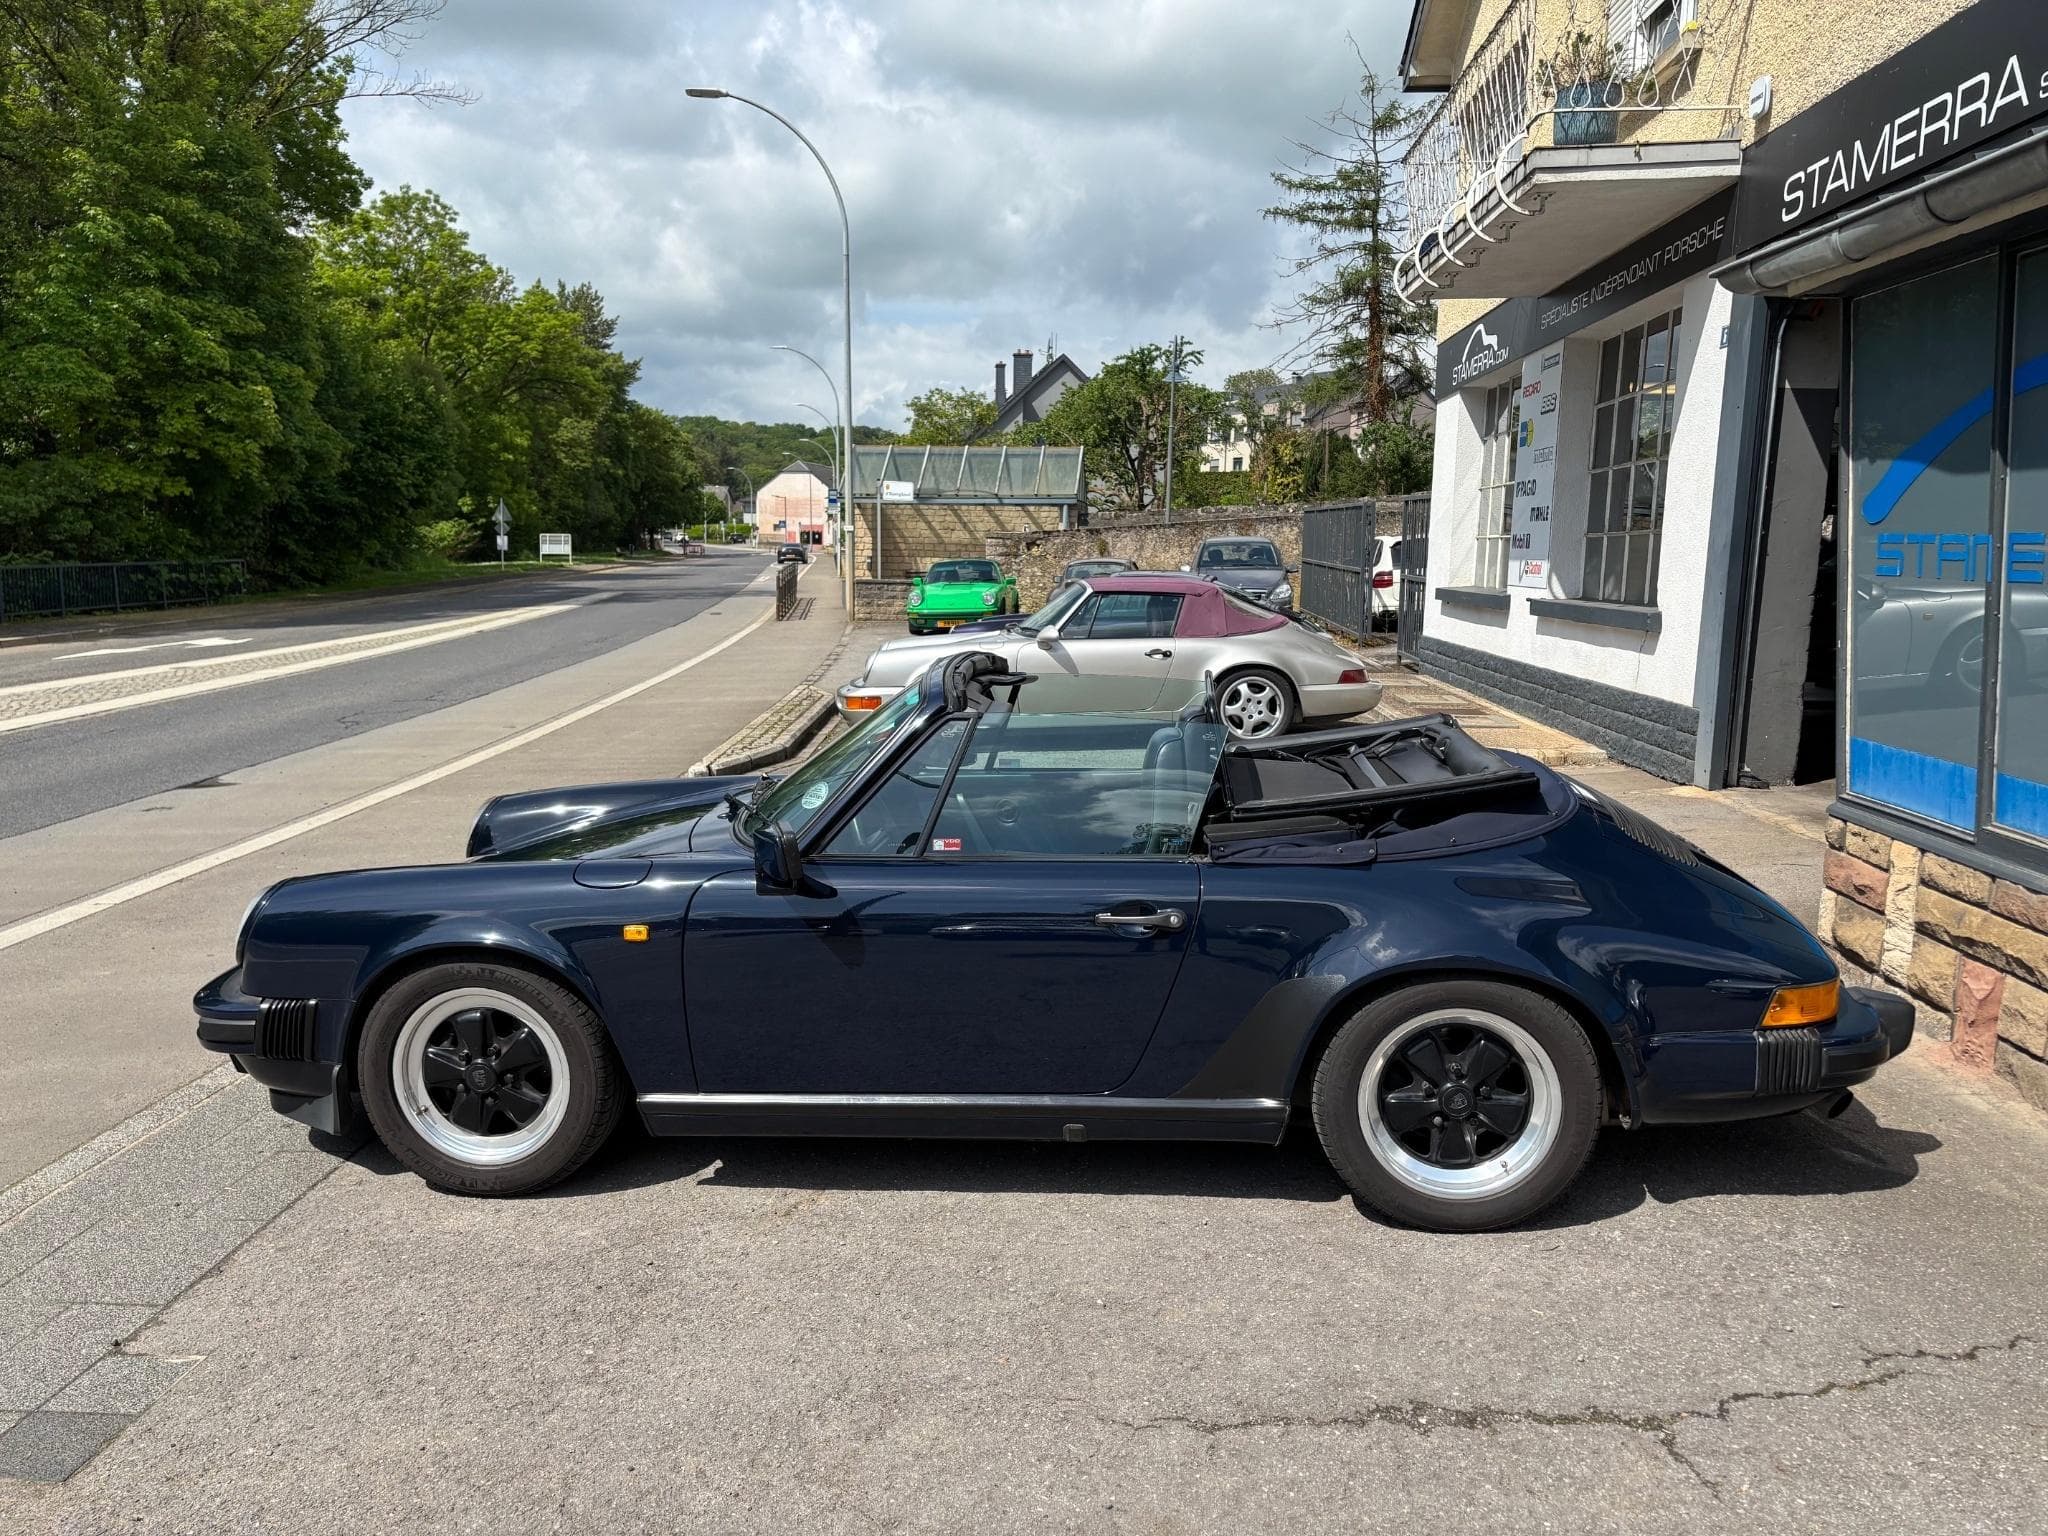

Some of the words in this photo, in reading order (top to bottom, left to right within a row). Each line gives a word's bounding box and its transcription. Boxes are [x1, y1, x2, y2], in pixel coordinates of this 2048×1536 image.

[1781, 54, 2030, 222] STAMERRA
[1540, 290, 1589, 330] SPÉCIALISTE
[1590, 250, 1662, 304] INDÉPENDANT
[1663, 216, 1726, 267] PORSCHE
[1452, 346, 1510, 386] STAMERRA.COM
[1523, 380, 1542, 399] RECARO
[1530, 505, 1550, 521] MAHLE
